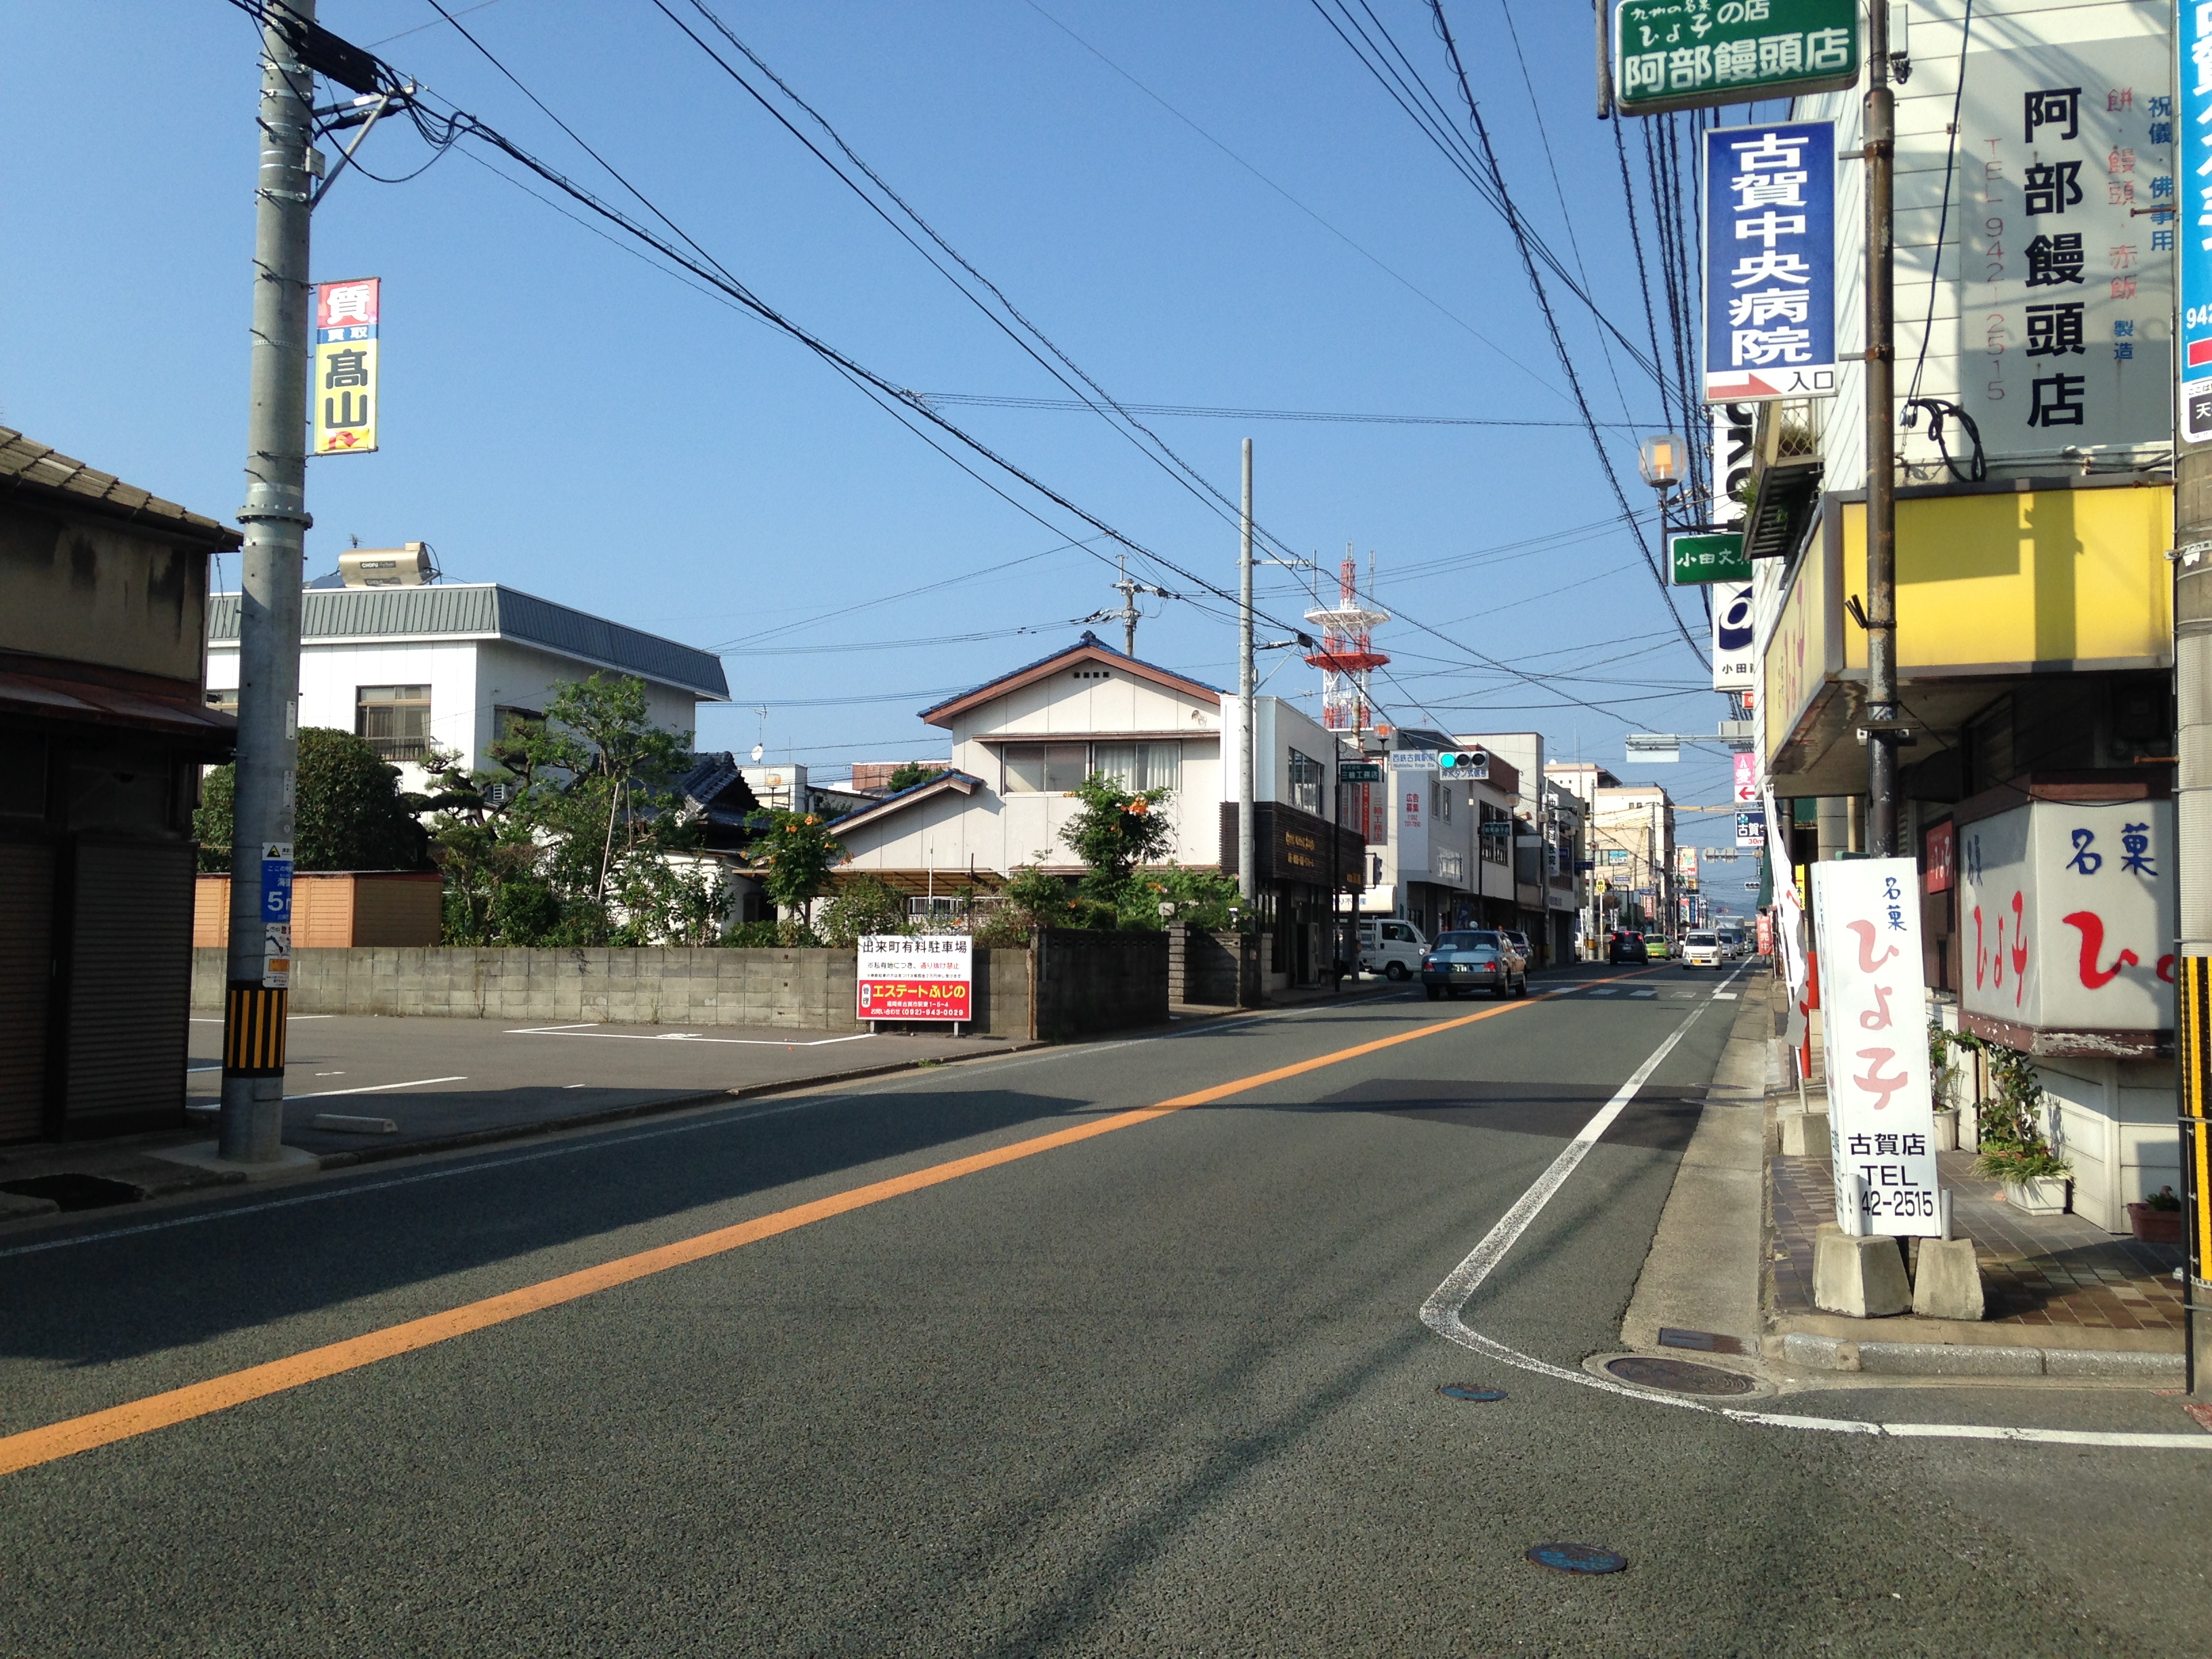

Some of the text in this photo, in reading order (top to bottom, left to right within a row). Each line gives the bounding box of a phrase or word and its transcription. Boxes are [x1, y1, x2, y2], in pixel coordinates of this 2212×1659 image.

[1624, 27, 1850, 96] 阿部饅頭店
[1729, 133, 1813, 367] 古賀中央病院
[2023, 87, 2086, 428] 阿部饅頭店
[327, 284, 370, 325] 質
[2114, 319, 2134, 361] 製造
[1787, 370, 1835, 391] 入口
[2196, 401, 2212, 420] 天
[2065, 822, 2158, 876] 名菓
[863, 941, 968, 954] 出来町有料駐車場
[872, 984, 966, 998] エステートふじの
[1848, 1133, 1925, 1156] 古賀店
[1860, 1165, 1919, 1186] TEL
[1849, 1190, 1933, 1217] 42-2515
